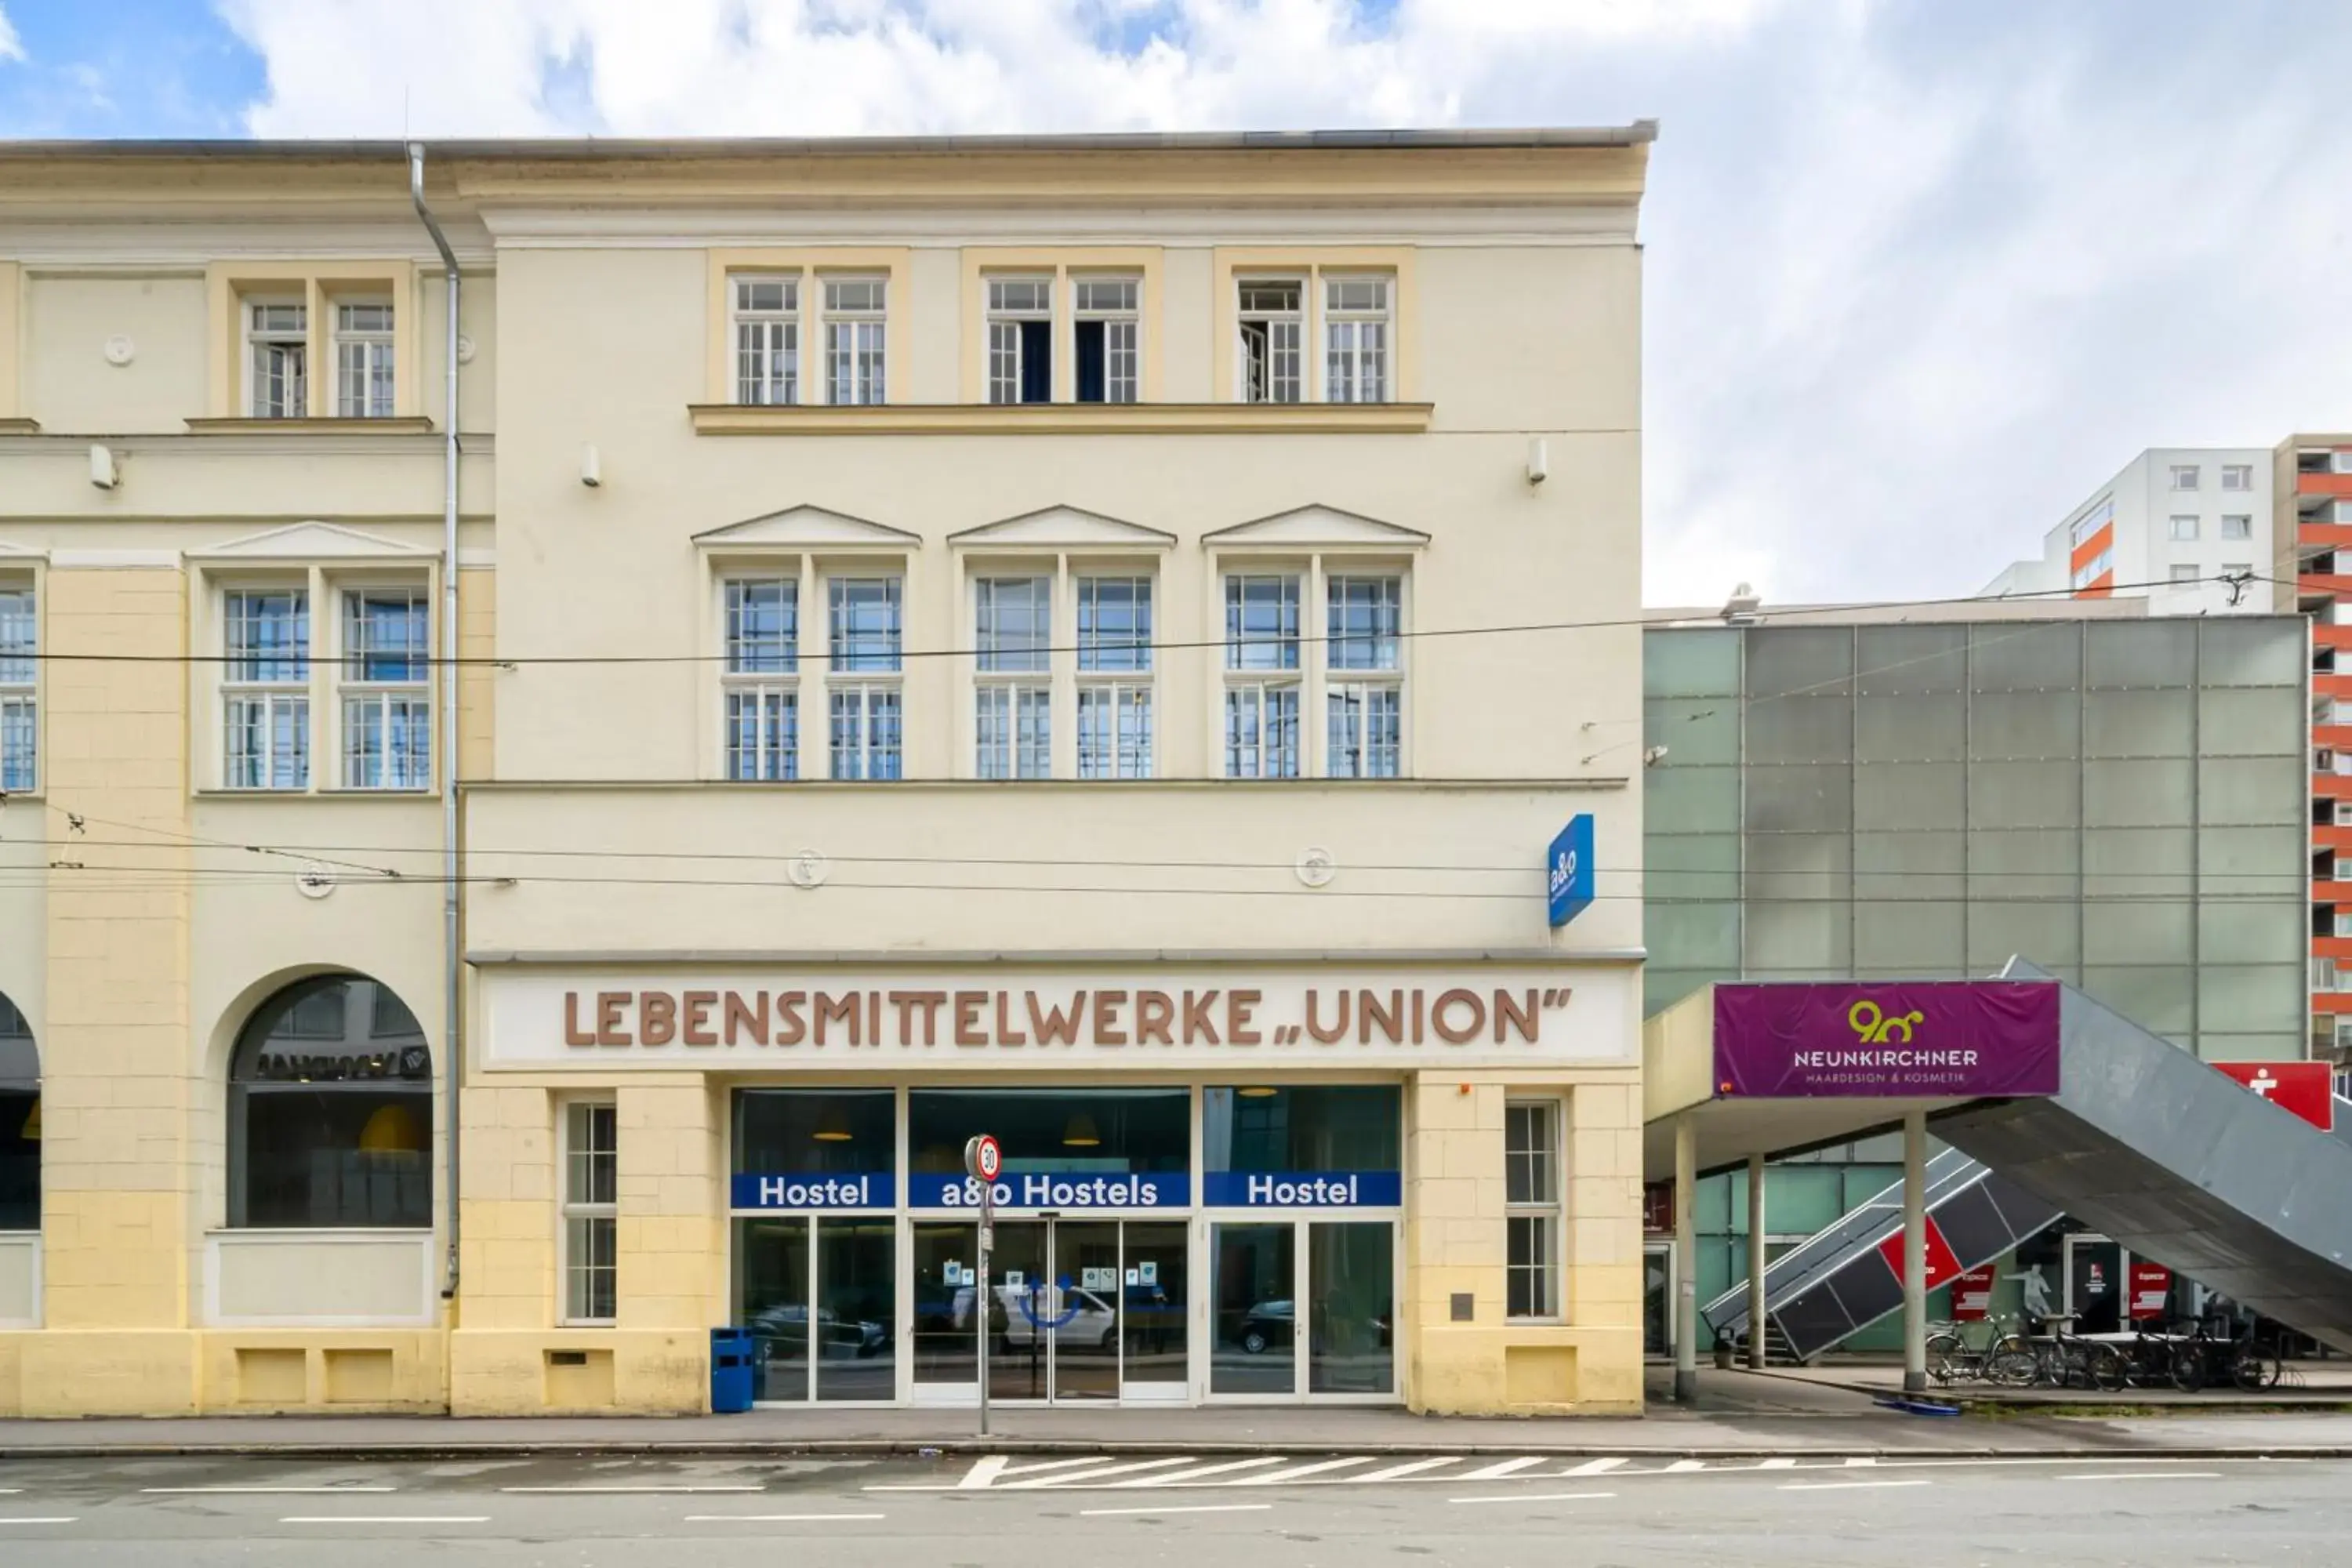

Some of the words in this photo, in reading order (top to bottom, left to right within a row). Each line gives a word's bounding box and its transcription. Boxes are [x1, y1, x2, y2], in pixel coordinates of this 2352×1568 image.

[1551, 850, 1576, 893] a&o
[564, 990, 1261, 1047] LEBENSMITTELWERKE
[1794, 1050, 1978, 1067] NEUNKIRCHNER
[1806, 1073, 1886, 1083] HAARDESIGN
[1891, 1073, 1899, 1083] &
[1904, 1073, 1965, 1083] KOSMETIK
[984, 1149, 994, 1169] 30
[759, 1176, 869, 1205] Hostel
[942, 1175, 1012, 1206] a&o
[1024, 1174, 1158, 1206] Hostels
[1249, 1174, 1358, 1205] Hostel
